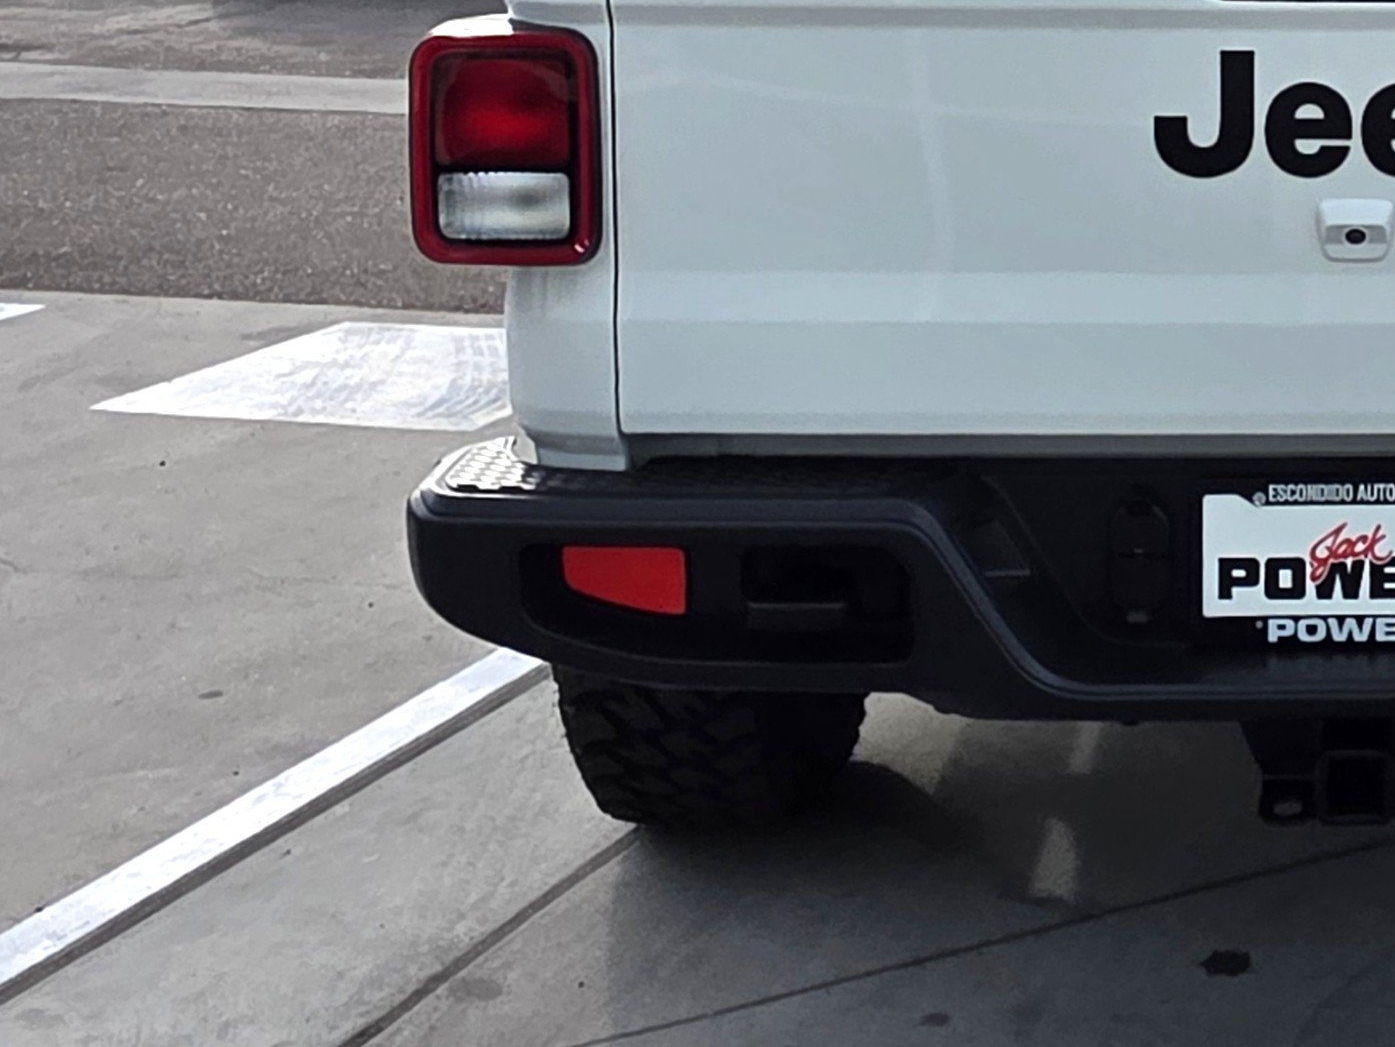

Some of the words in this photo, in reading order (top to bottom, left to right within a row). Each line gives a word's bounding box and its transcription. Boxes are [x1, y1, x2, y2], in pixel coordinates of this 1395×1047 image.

[1268, 484, 1353, 502] ESCONDIDO
[1357, 483, 1395, 501] AUTO
[1310, 522, 1393, 582] Jack
